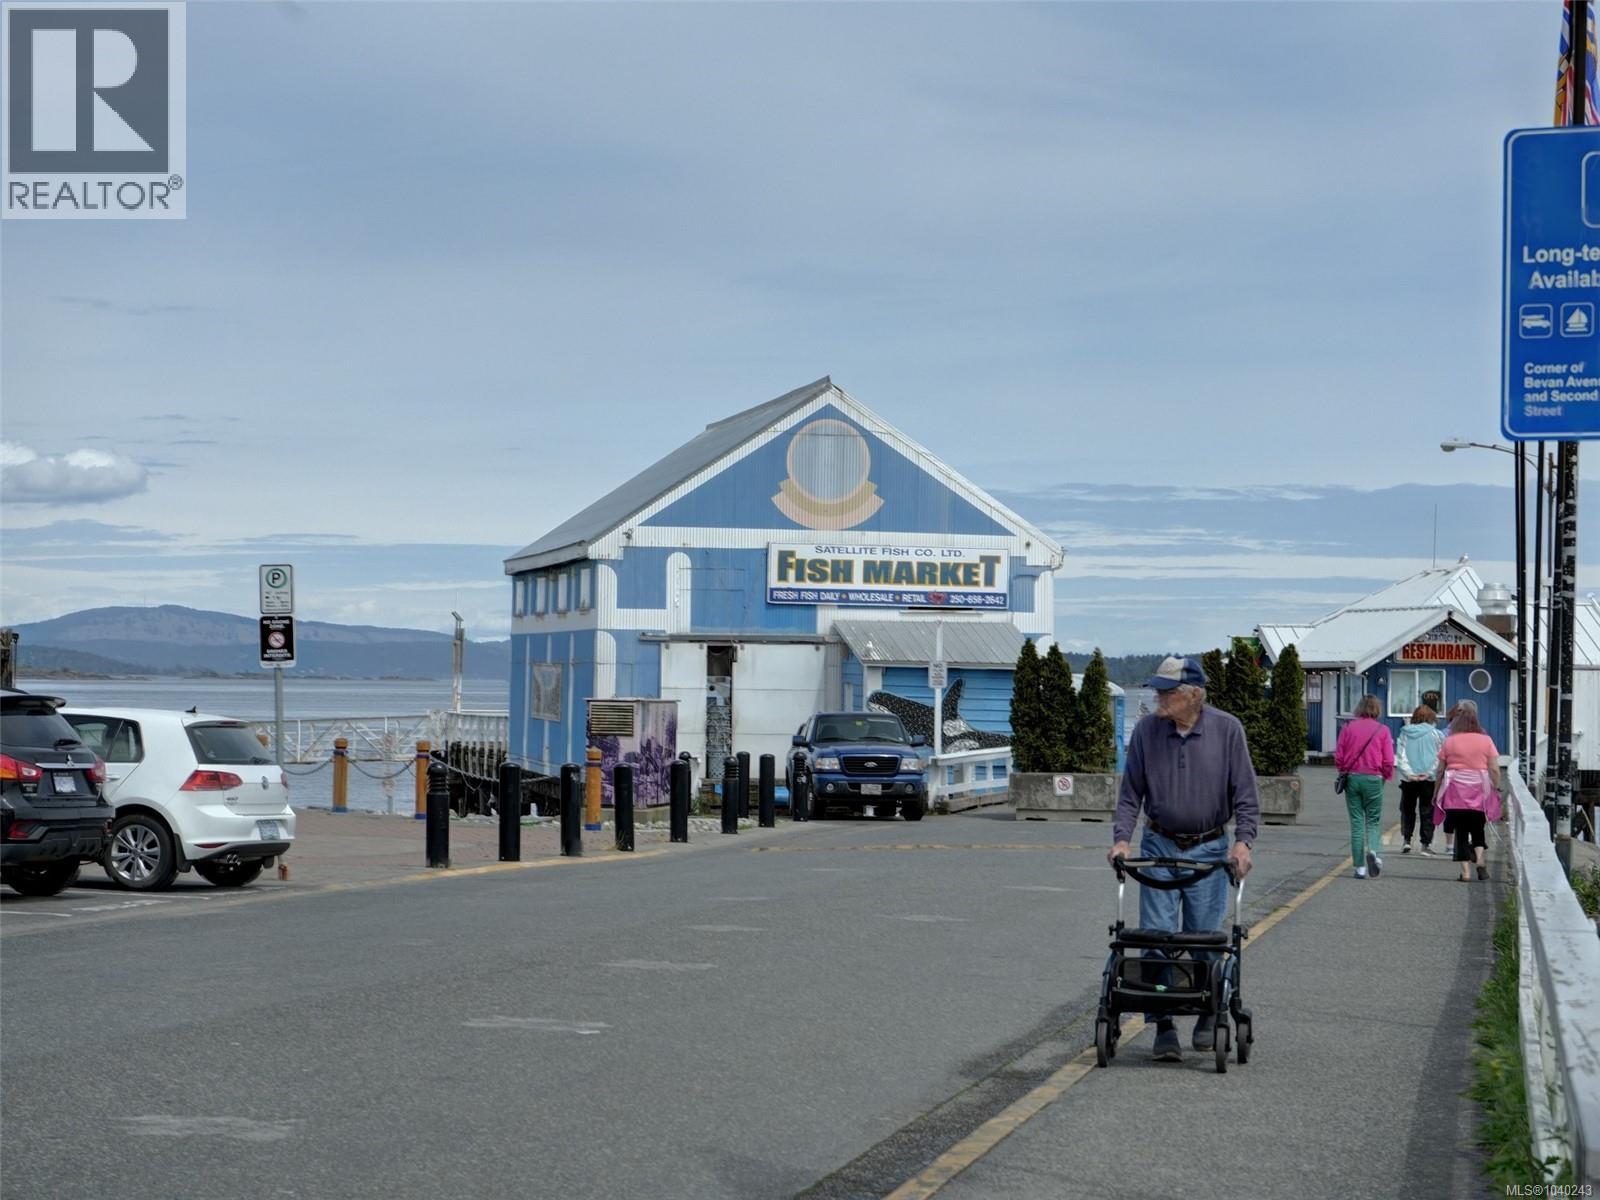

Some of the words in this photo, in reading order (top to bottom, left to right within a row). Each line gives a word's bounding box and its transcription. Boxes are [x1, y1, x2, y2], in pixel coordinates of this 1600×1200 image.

[1522, 244, 1600, 266] Long-te
[1528, 270, 1600, 289] Availab
[1524, 362, 1568, 374] Corner
[1570, 361, 1585, 373] of
[1524, 376, 1564, 388] Bevan
[1566, 375, 1600, 387] Aven
[1524, 390, 1548, 402] and
[1551, 389, 1599, 402] Second
[1524, 404, 1562, 416] Street
[815, 545, 878, 555] SATELLITE
[881, 547, 910, 557] FISH
[914, 548, 937, 557] CO.
[941, 549, 966, 558] LTD.
[776, 550, 855, 584] FISH
[862, 555, 1002, 587] MARKET
[271, 572, 281, 584] P
[773, 590, 799, 601] FRESH
[800, 591, 819, 601] FISH
[820, 592, 841, 602] DAILY
[847, 592, 894, 603] WHOLESALE
[901, 593, 928, 604] RETAIL
[1402, 643, 1476, 660] RESTAURANT
